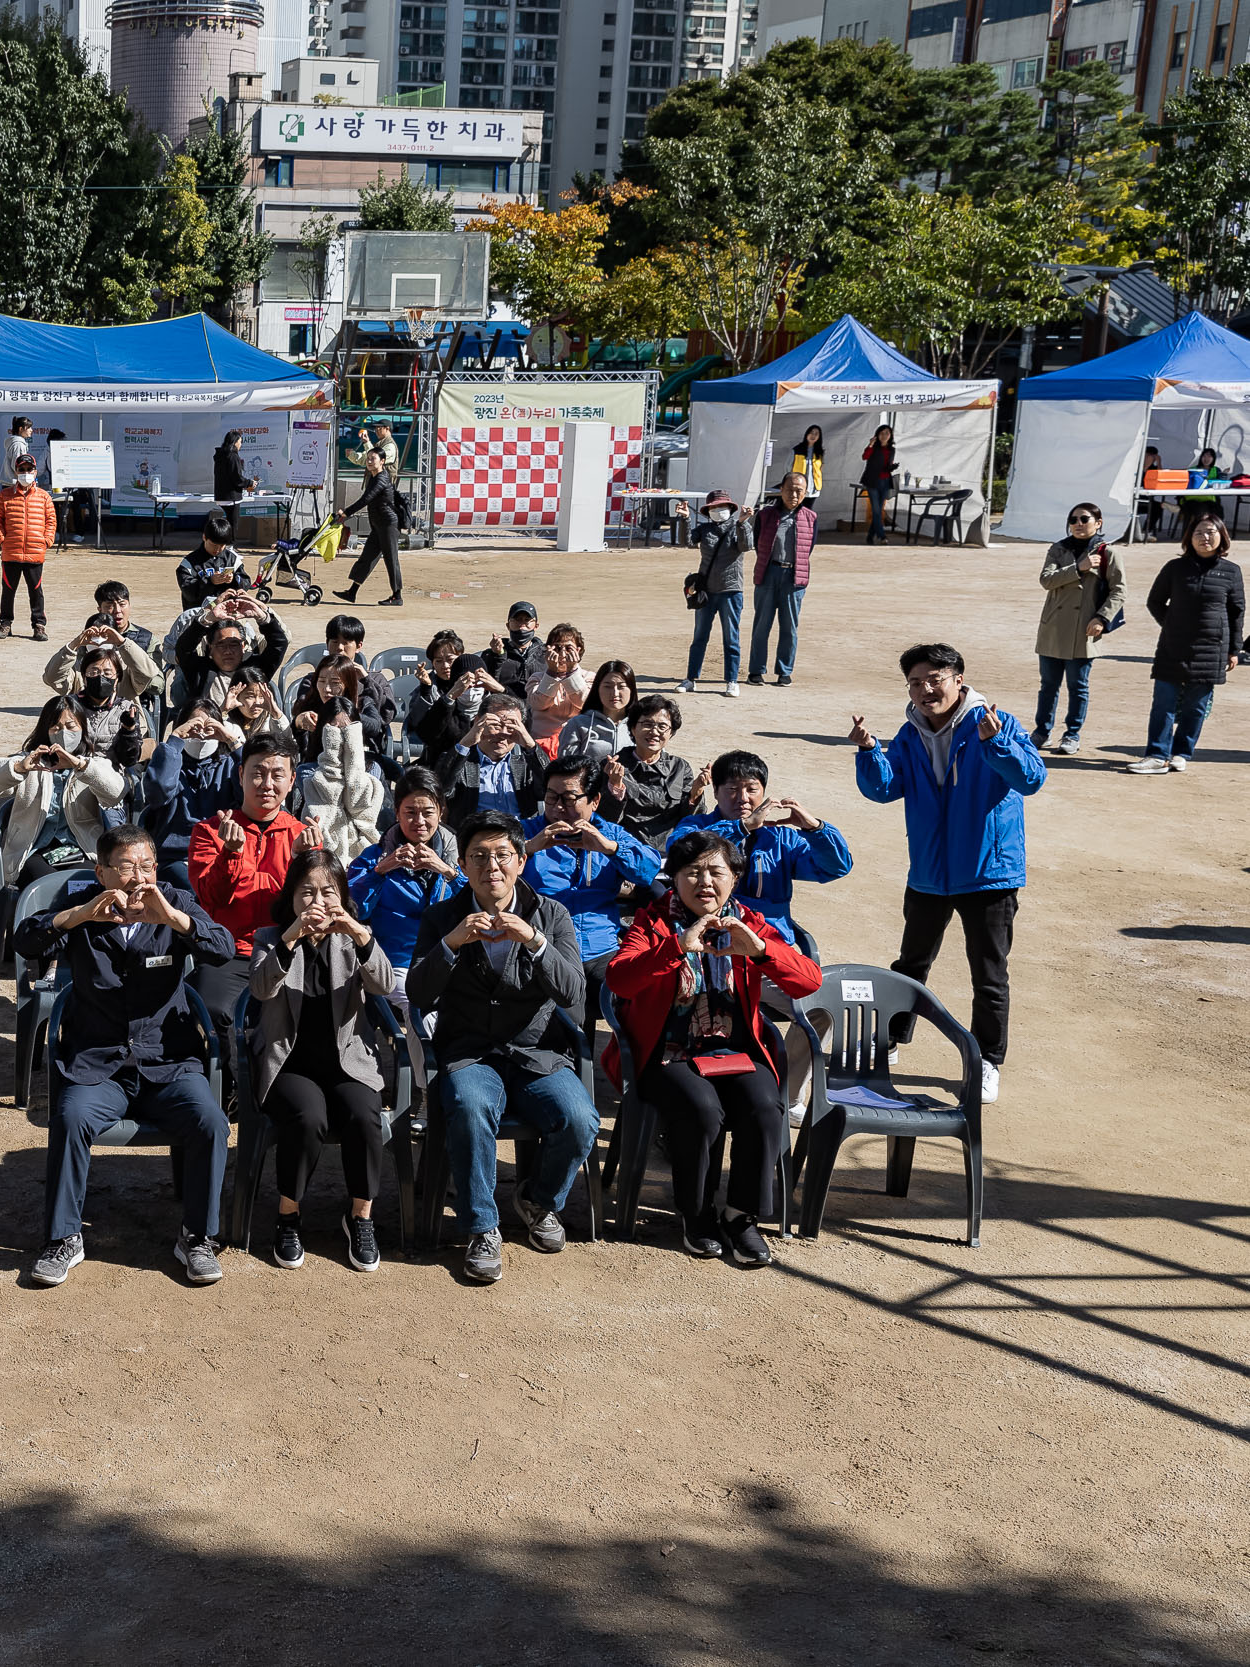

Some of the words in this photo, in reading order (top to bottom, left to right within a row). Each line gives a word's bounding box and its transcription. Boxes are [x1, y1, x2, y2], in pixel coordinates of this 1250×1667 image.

[314, 116, 365, 139] 사랑
[375, 118, 448, 143] 가득한
[458, 121, 506, 142] 치과
[9, 390, 40, 402] 행복할
[42, 390, 74, 402] 광진구
[76, 390, 116, 402] 청소년과
[118, 391, 170, 403] 함께합니다
[473, 393, 505, 405] 2023년
[830, 393, 850, 405] 우리
[852, 393, 892, 405] 가족사진
[894, 393, 914, 405] 액자
[917, 393, 946, 405] 꾸미기
[473, 406, 497, 420] 광진
[558, 405, 605, 419] 가족축제
